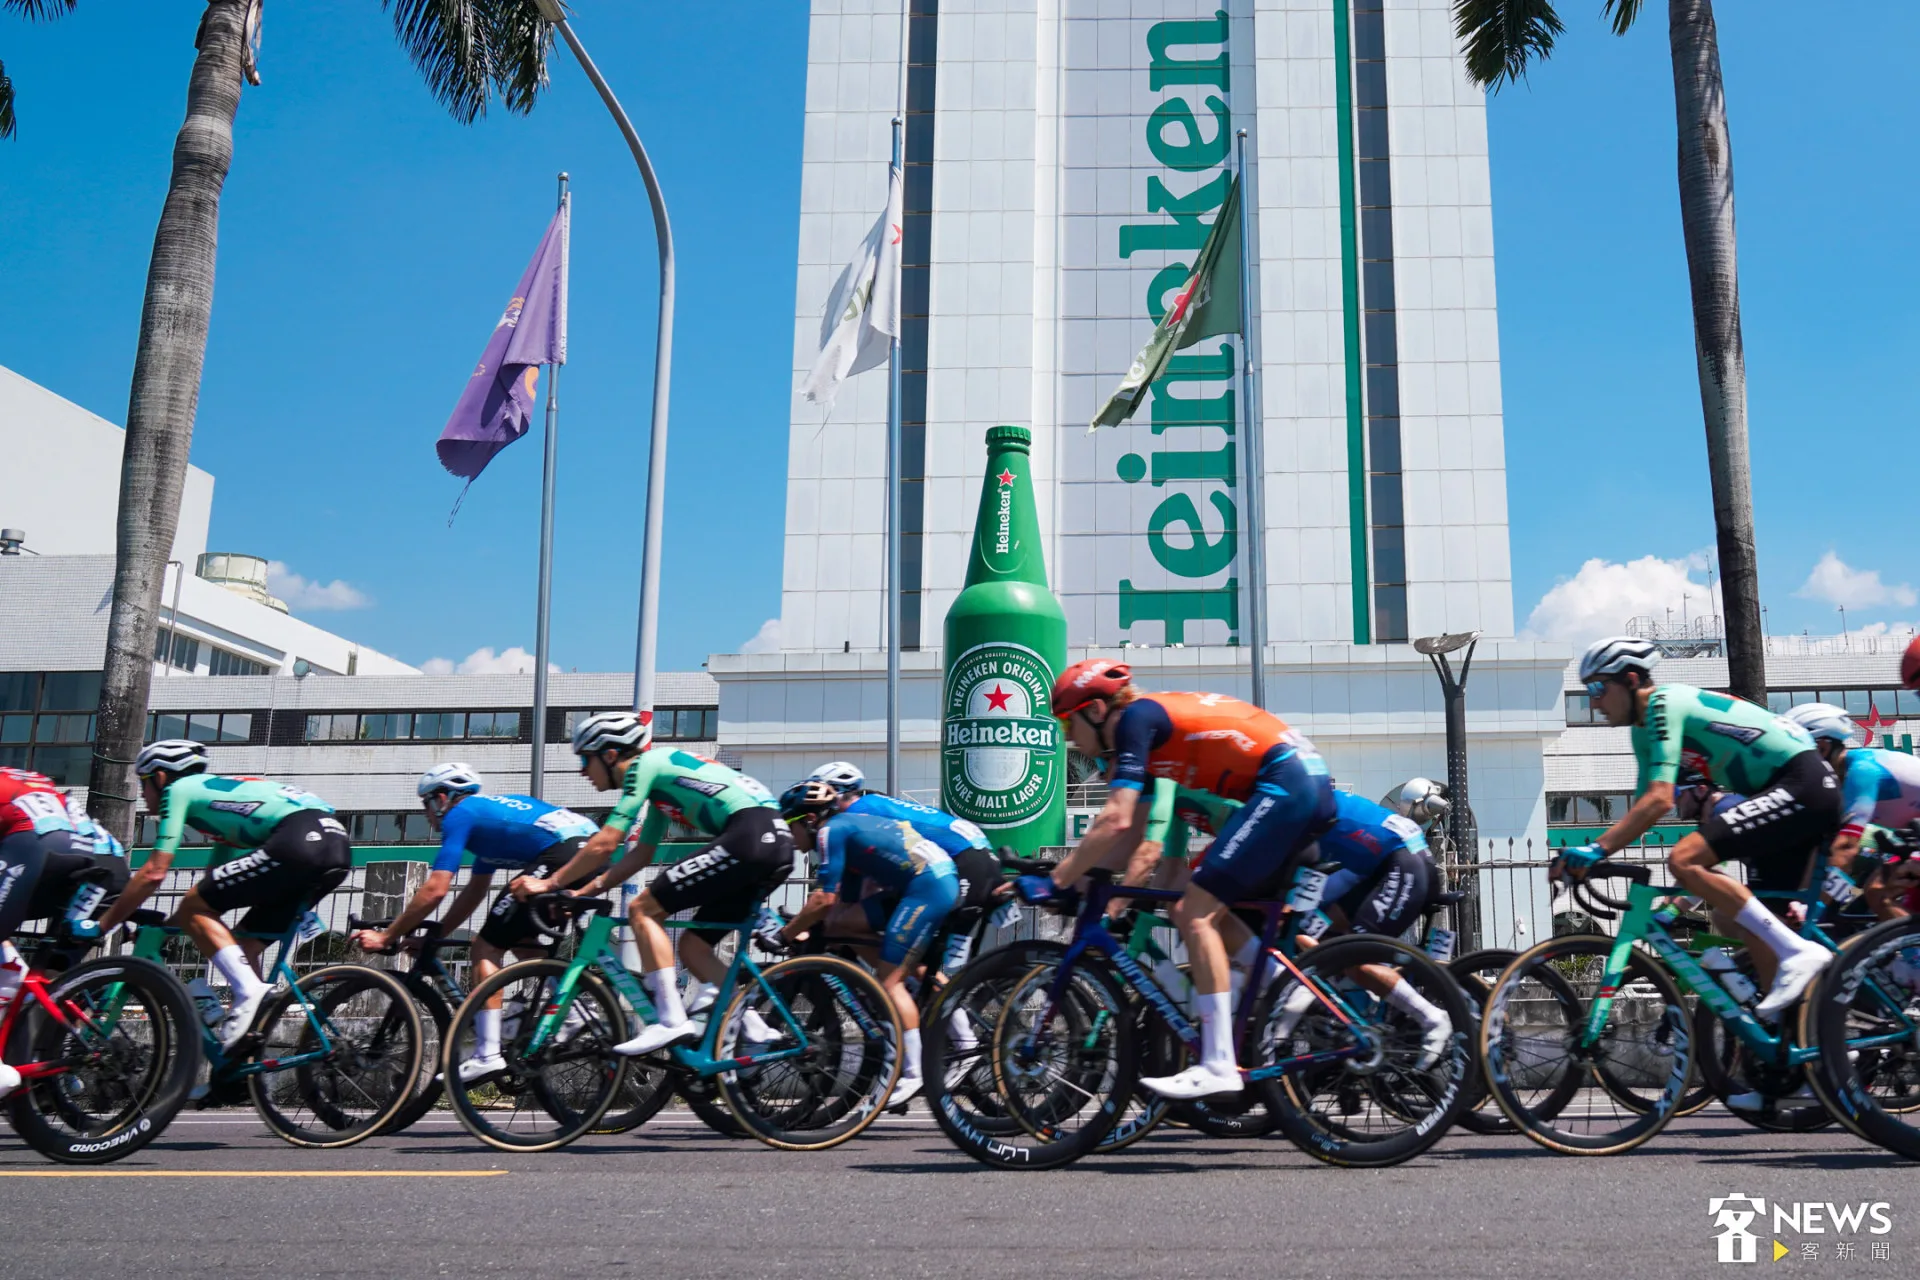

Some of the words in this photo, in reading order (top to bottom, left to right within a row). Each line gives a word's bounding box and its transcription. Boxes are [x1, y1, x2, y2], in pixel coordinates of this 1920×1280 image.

[995, 490, 1011, 553] Heineken
[1010, 653, 1026, 662] LAGER
[954, 661, 998, 707] HEINEKEN
[1003, 661, 1046, 707] ORIGINAL
[947, 722, 1053, 746] Heineken
[952, 773, 974, 802] PURE
[975, 794, 1008, 808] MALT
[1012, 773, 1043, 805] LAGER
[1720, 788, 1795, 825] KERN
[998, 809, 1025, 818] HEINEKEN
[212, 849, 271, 881] KERN
[666, 845, 730, 883] KERN
[1112, 951, 1200, 1042] WINSPACE
